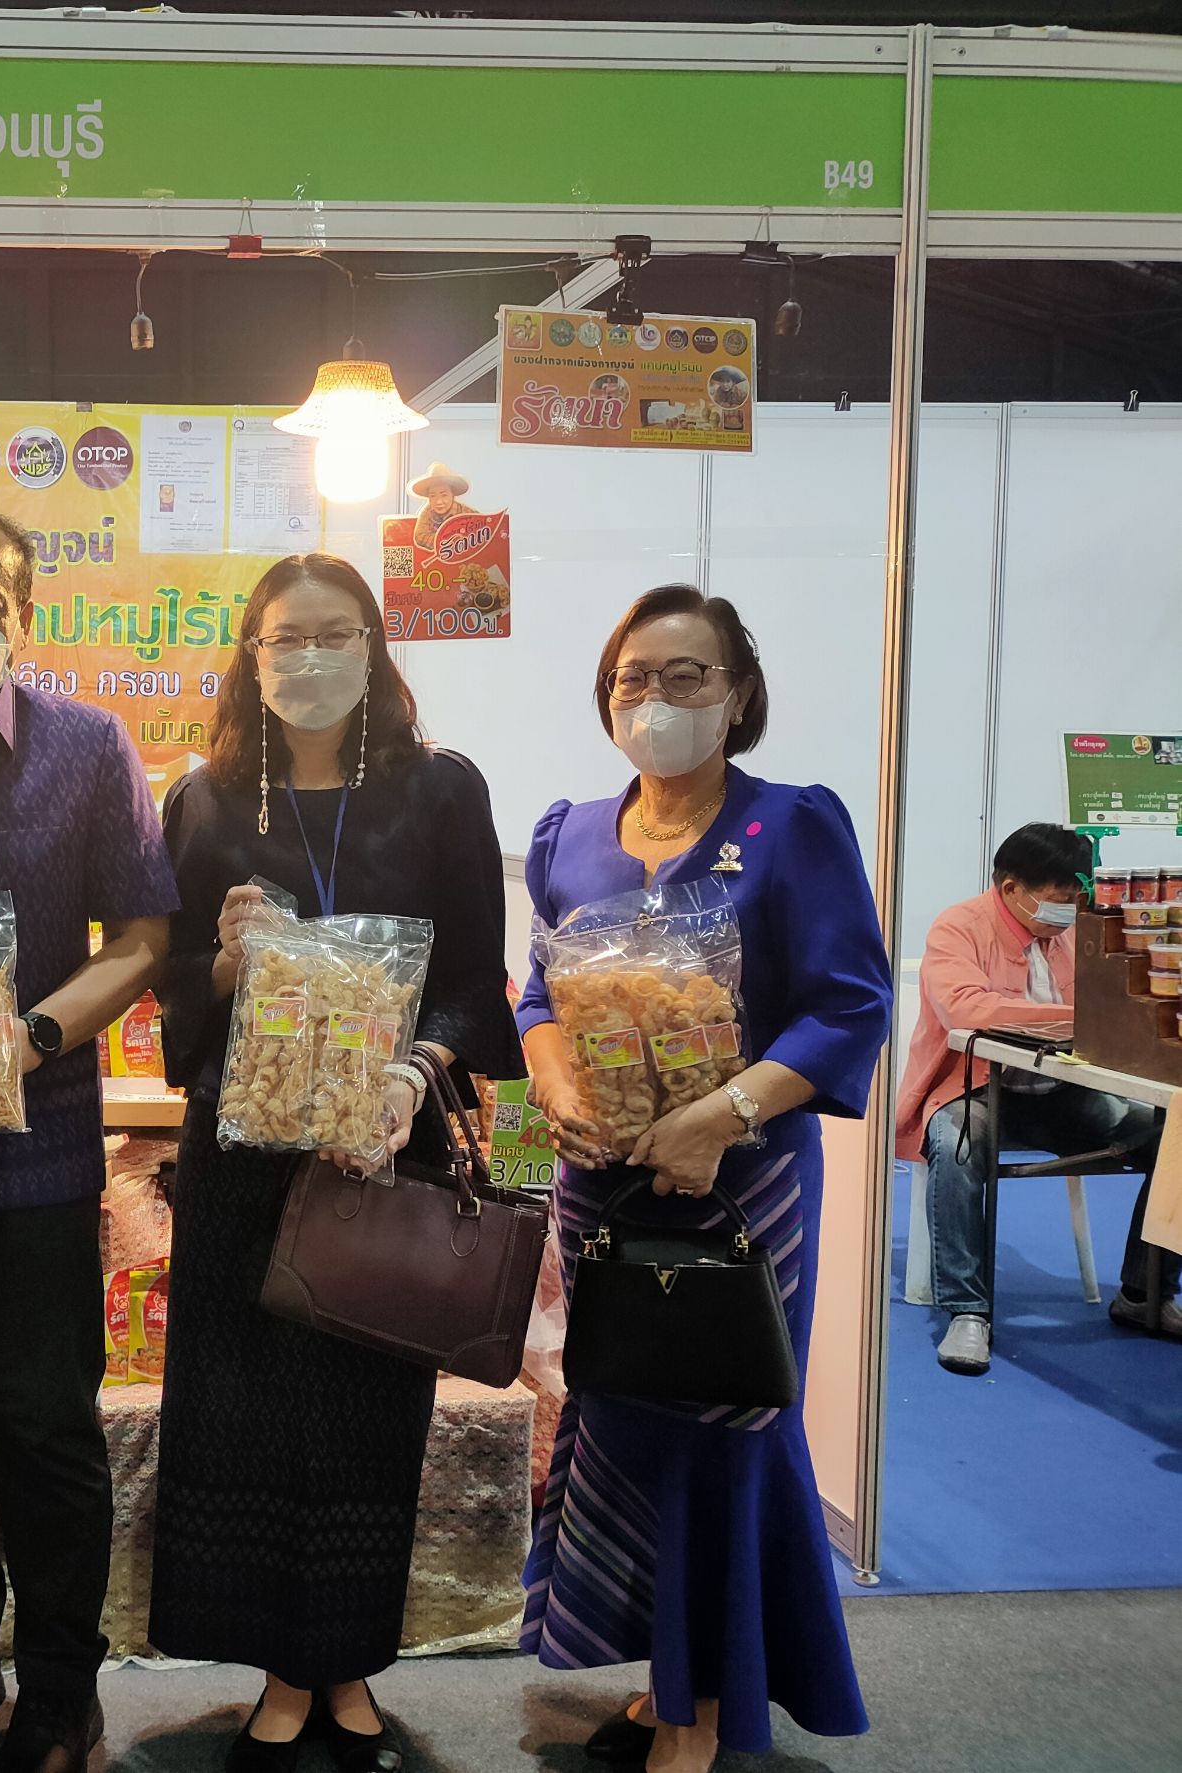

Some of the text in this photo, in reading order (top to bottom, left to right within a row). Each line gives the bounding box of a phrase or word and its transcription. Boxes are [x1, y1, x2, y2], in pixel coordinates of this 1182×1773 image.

[824, 160, 874, 189] B49
[77, 446, 128, 461] OTOP
[97, 671, 181, 698] กรอบ
[492, 1144, 524, 1157] พิเศษ
[491, 1158, 554, 1185] 3/10
